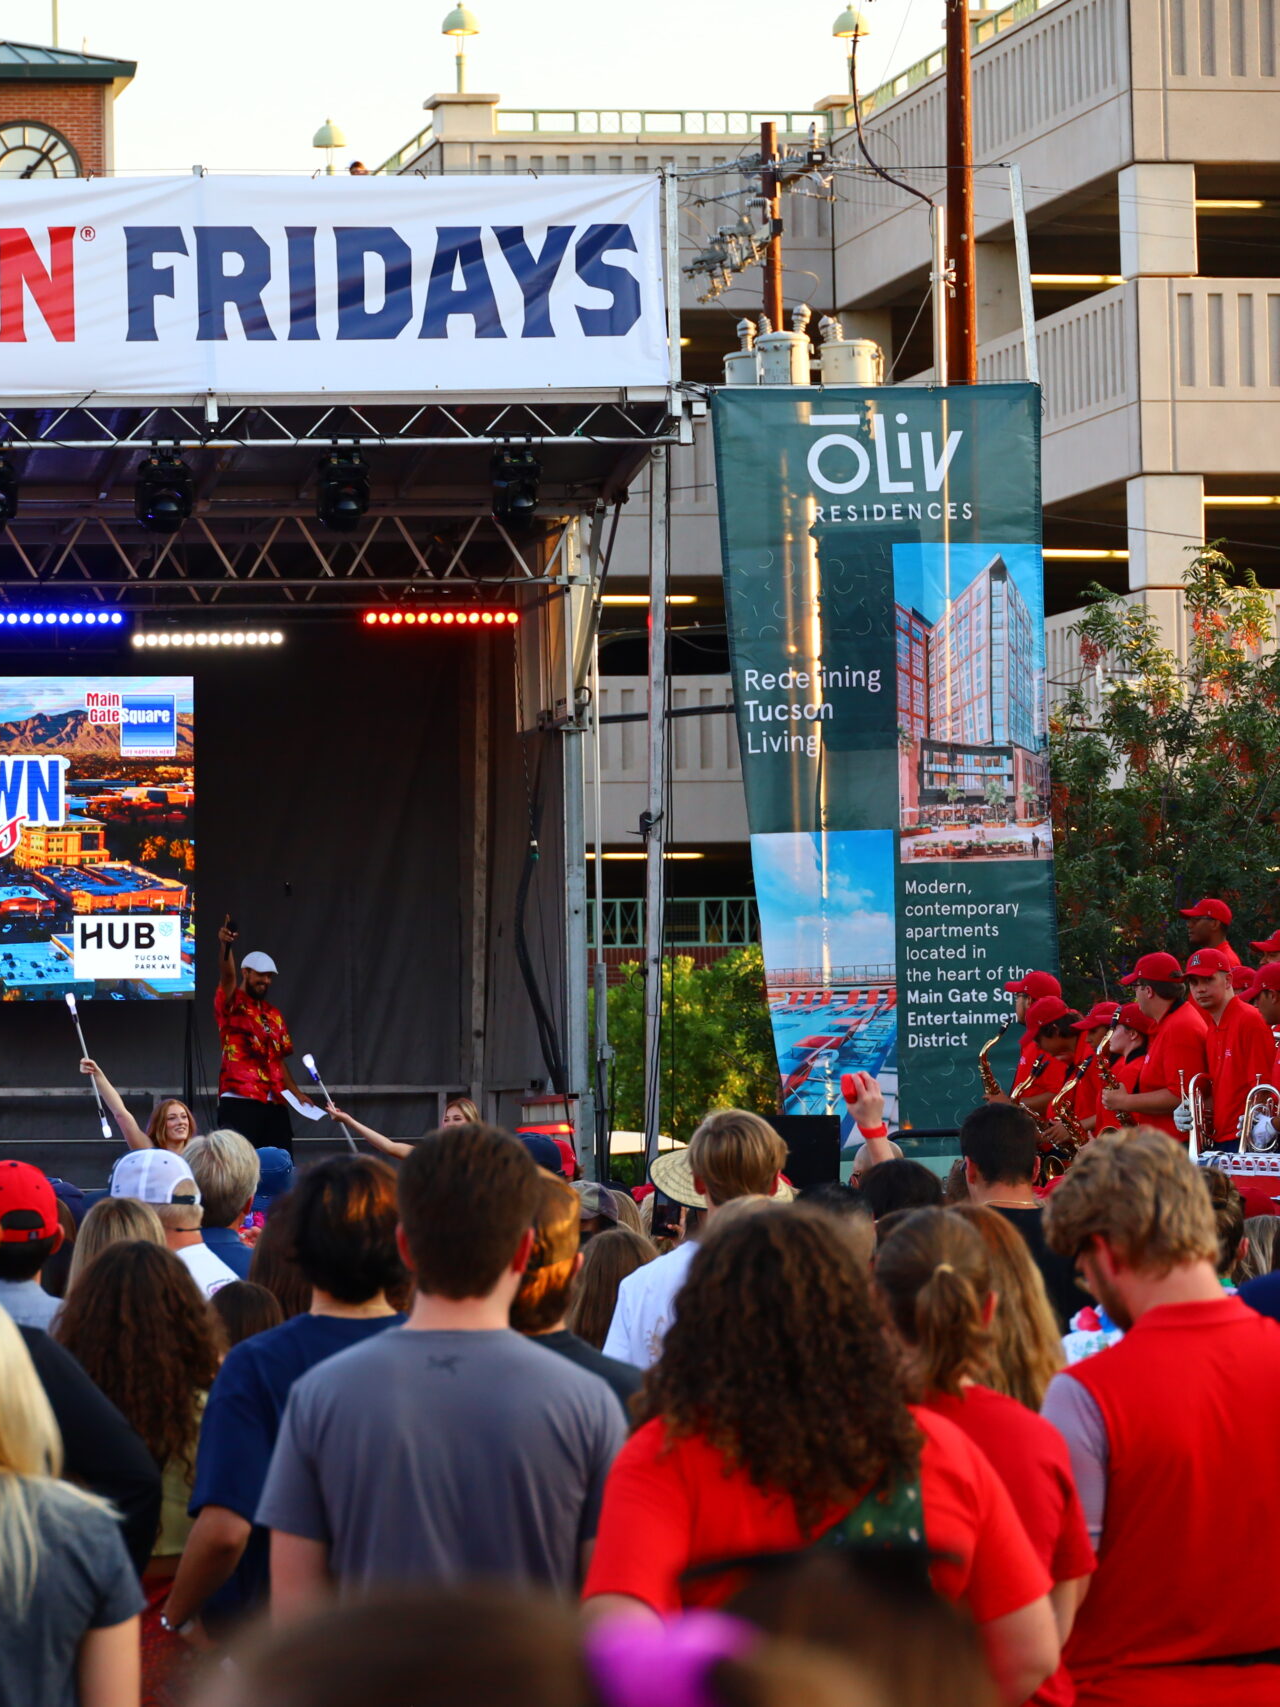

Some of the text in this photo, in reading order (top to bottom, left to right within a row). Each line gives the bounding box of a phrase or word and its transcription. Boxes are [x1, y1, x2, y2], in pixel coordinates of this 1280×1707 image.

[123, 223, 641, 341] FRIDAYS
[815, 502, 973, 523] RESIDENCES
[744, 665, 881, 693] Redeining
[86, 692, 120, 707] Main
[90, 708, 170, 724] Gate Square
[744, 700, 833, 722] Tucson
[747, 730, 819, 758] Living
[905, 879, 972, 895] Modern,
[905, 902, 1019, 917] contemporary
[81, 922, 155, 949] HUB
[905, 923, 999, 941] apartments
[906, 945, 986, 960] located in
[906, 967, 931, 982] the
[937, 967, 981, 981] heart
[986, 966, 1003, 980] of
[907, 990, 943, 1004] Main
[948, 988, 988, 1004] Gate
[908, 1011, 1018, 1027] Entertainmen
[908, 1033, 968, 1048] District
